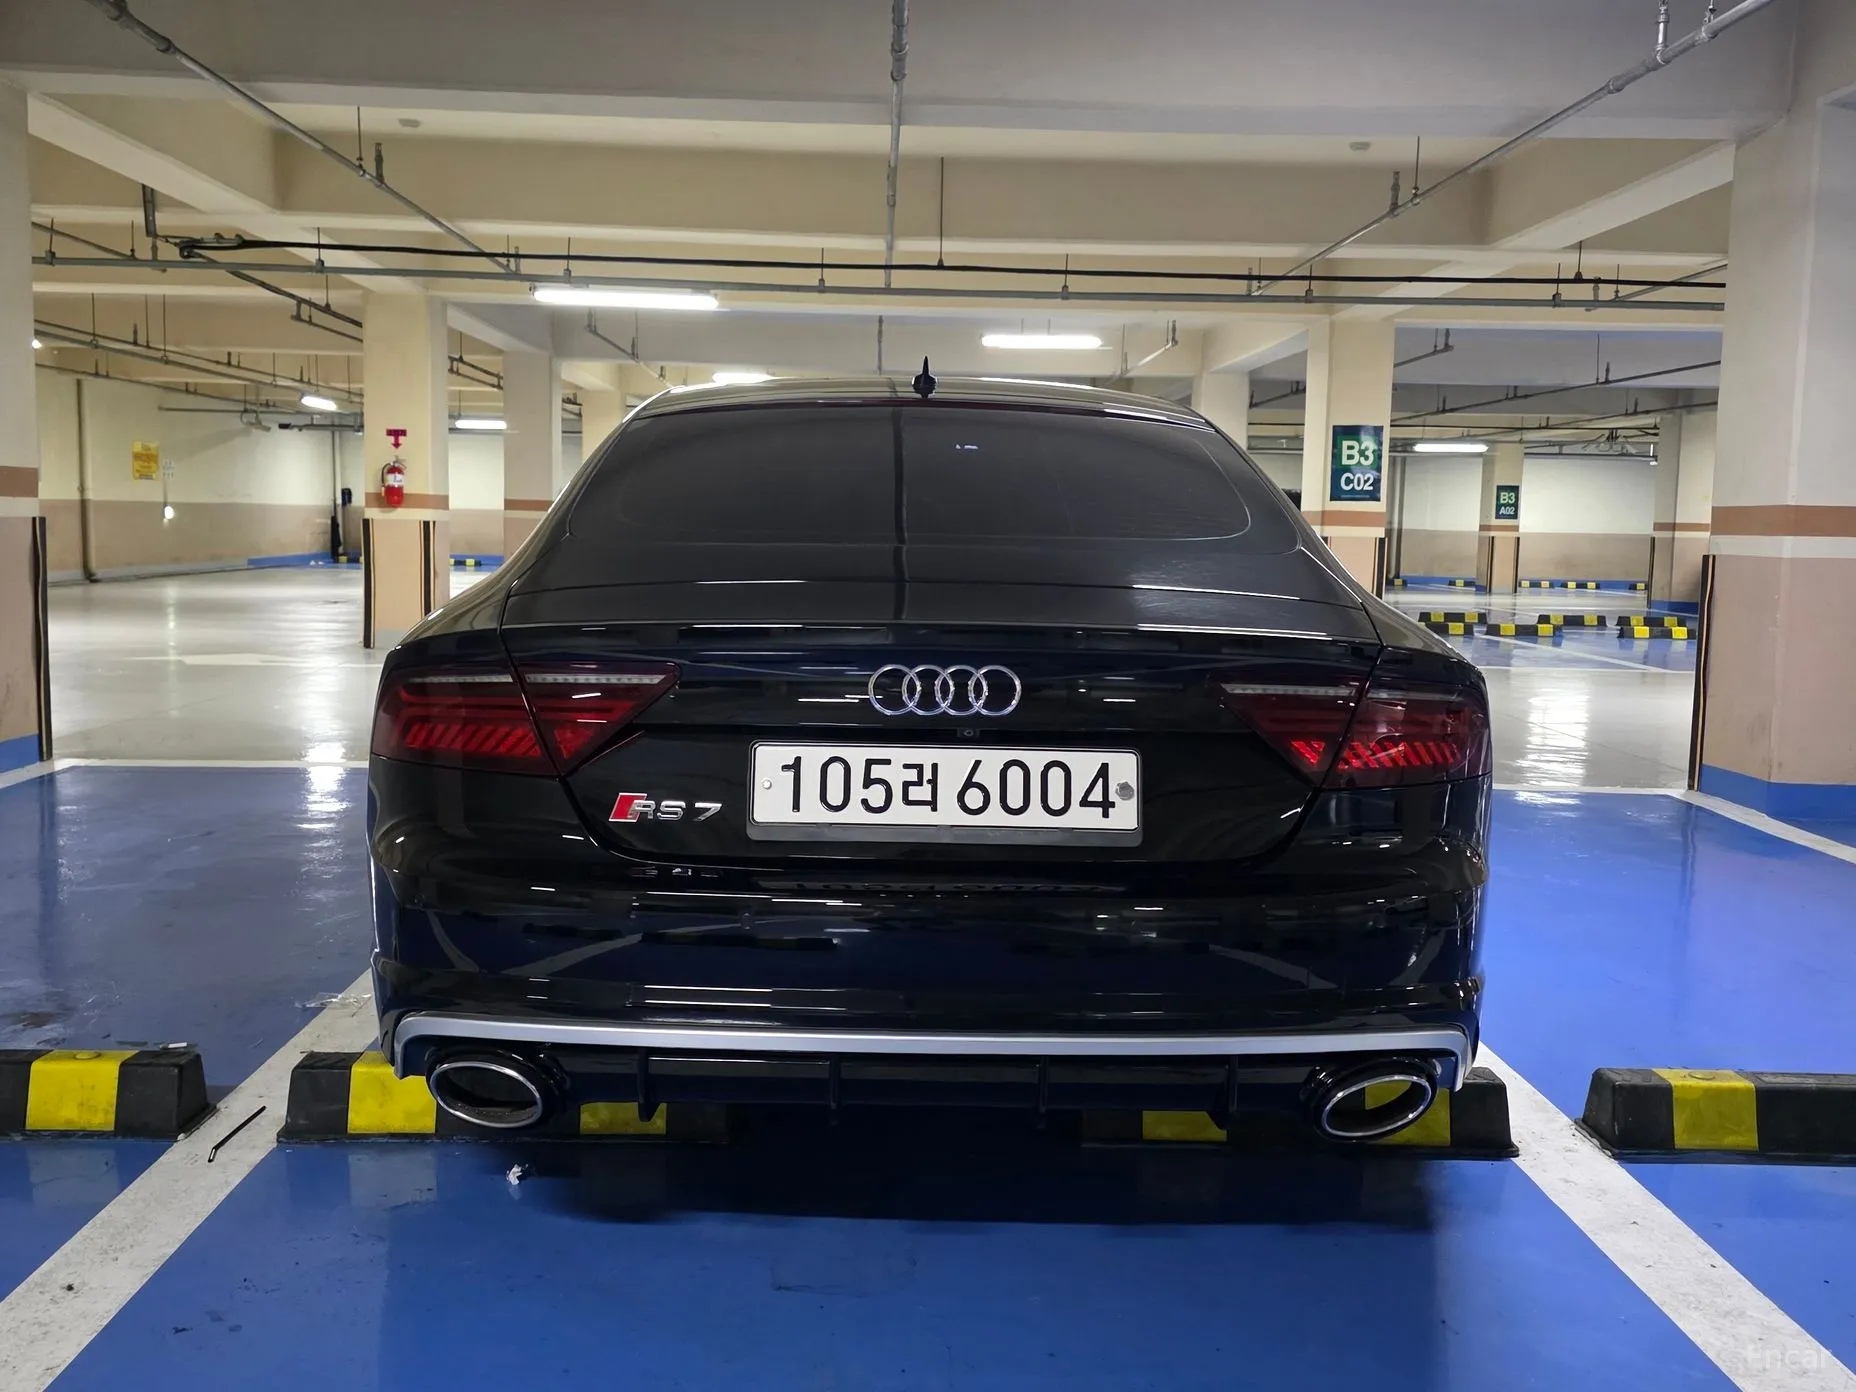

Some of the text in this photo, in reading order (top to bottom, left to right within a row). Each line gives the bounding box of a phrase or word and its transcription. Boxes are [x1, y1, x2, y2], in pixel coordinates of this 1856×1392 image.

[1341, 440, 1375, 466] B3
[1340, 472, 1375, 491] C02
[1500, 492, 1515, 504] B3
[1499, 506, 1516, 515] A02
